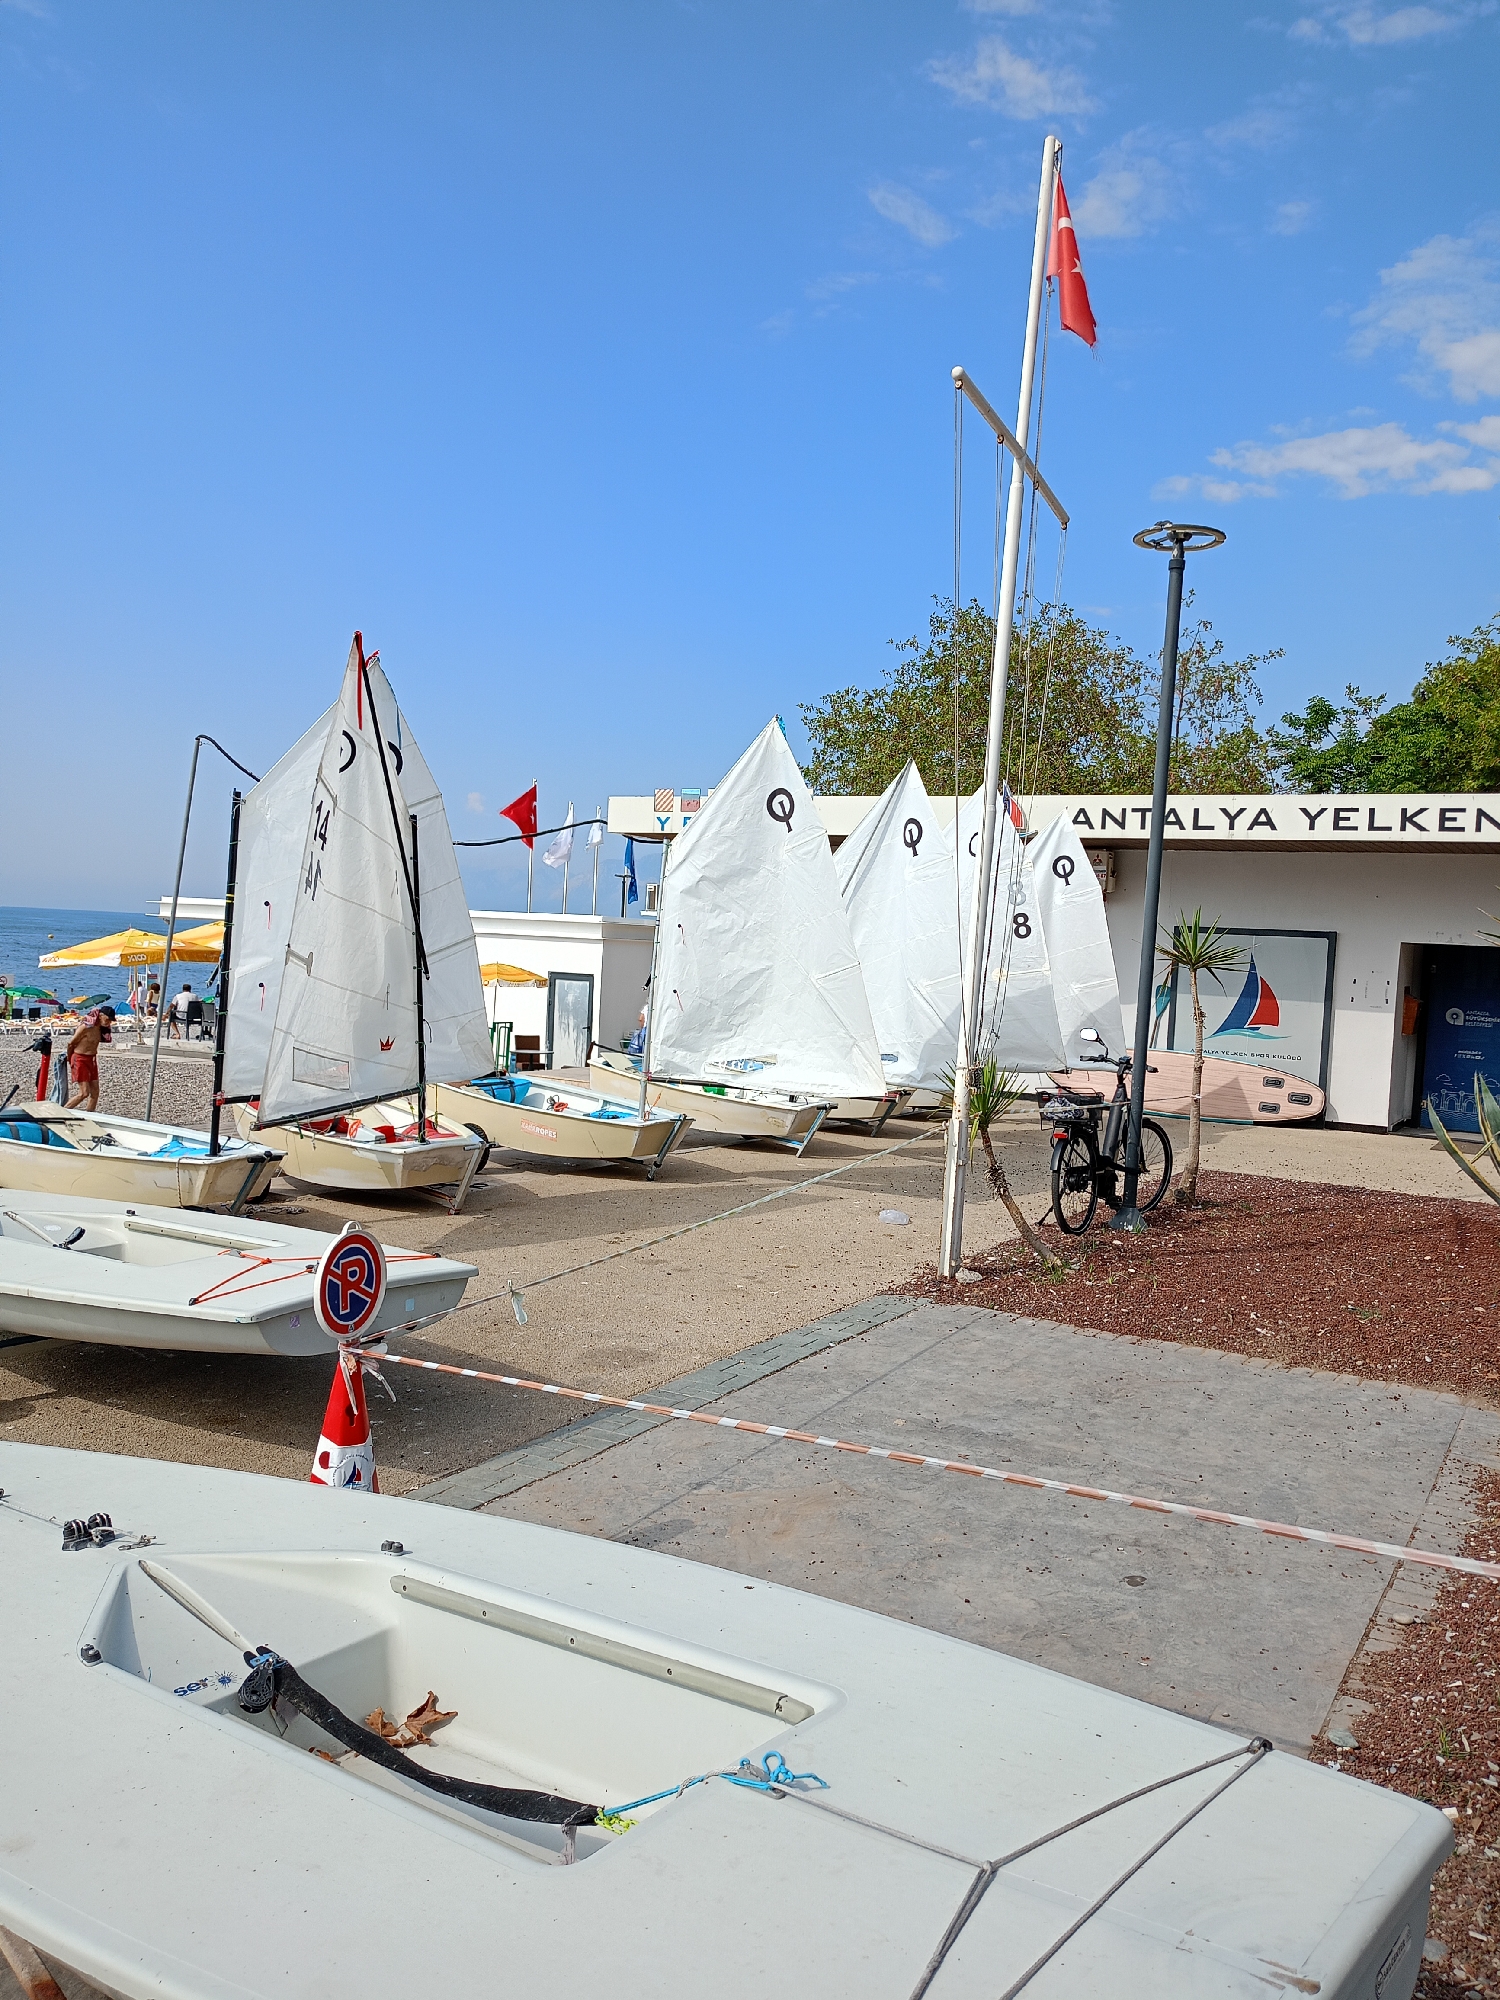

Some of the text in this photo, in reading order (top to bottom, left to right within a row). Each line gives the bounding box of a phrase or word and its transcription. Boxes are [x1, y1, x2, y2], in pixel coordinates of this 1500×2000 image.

[313, 800, 330, 851] 14
[1072, 807, 1500, 832] ANTALYA YELKEN
[1013, 913, 1031, 939] 8
